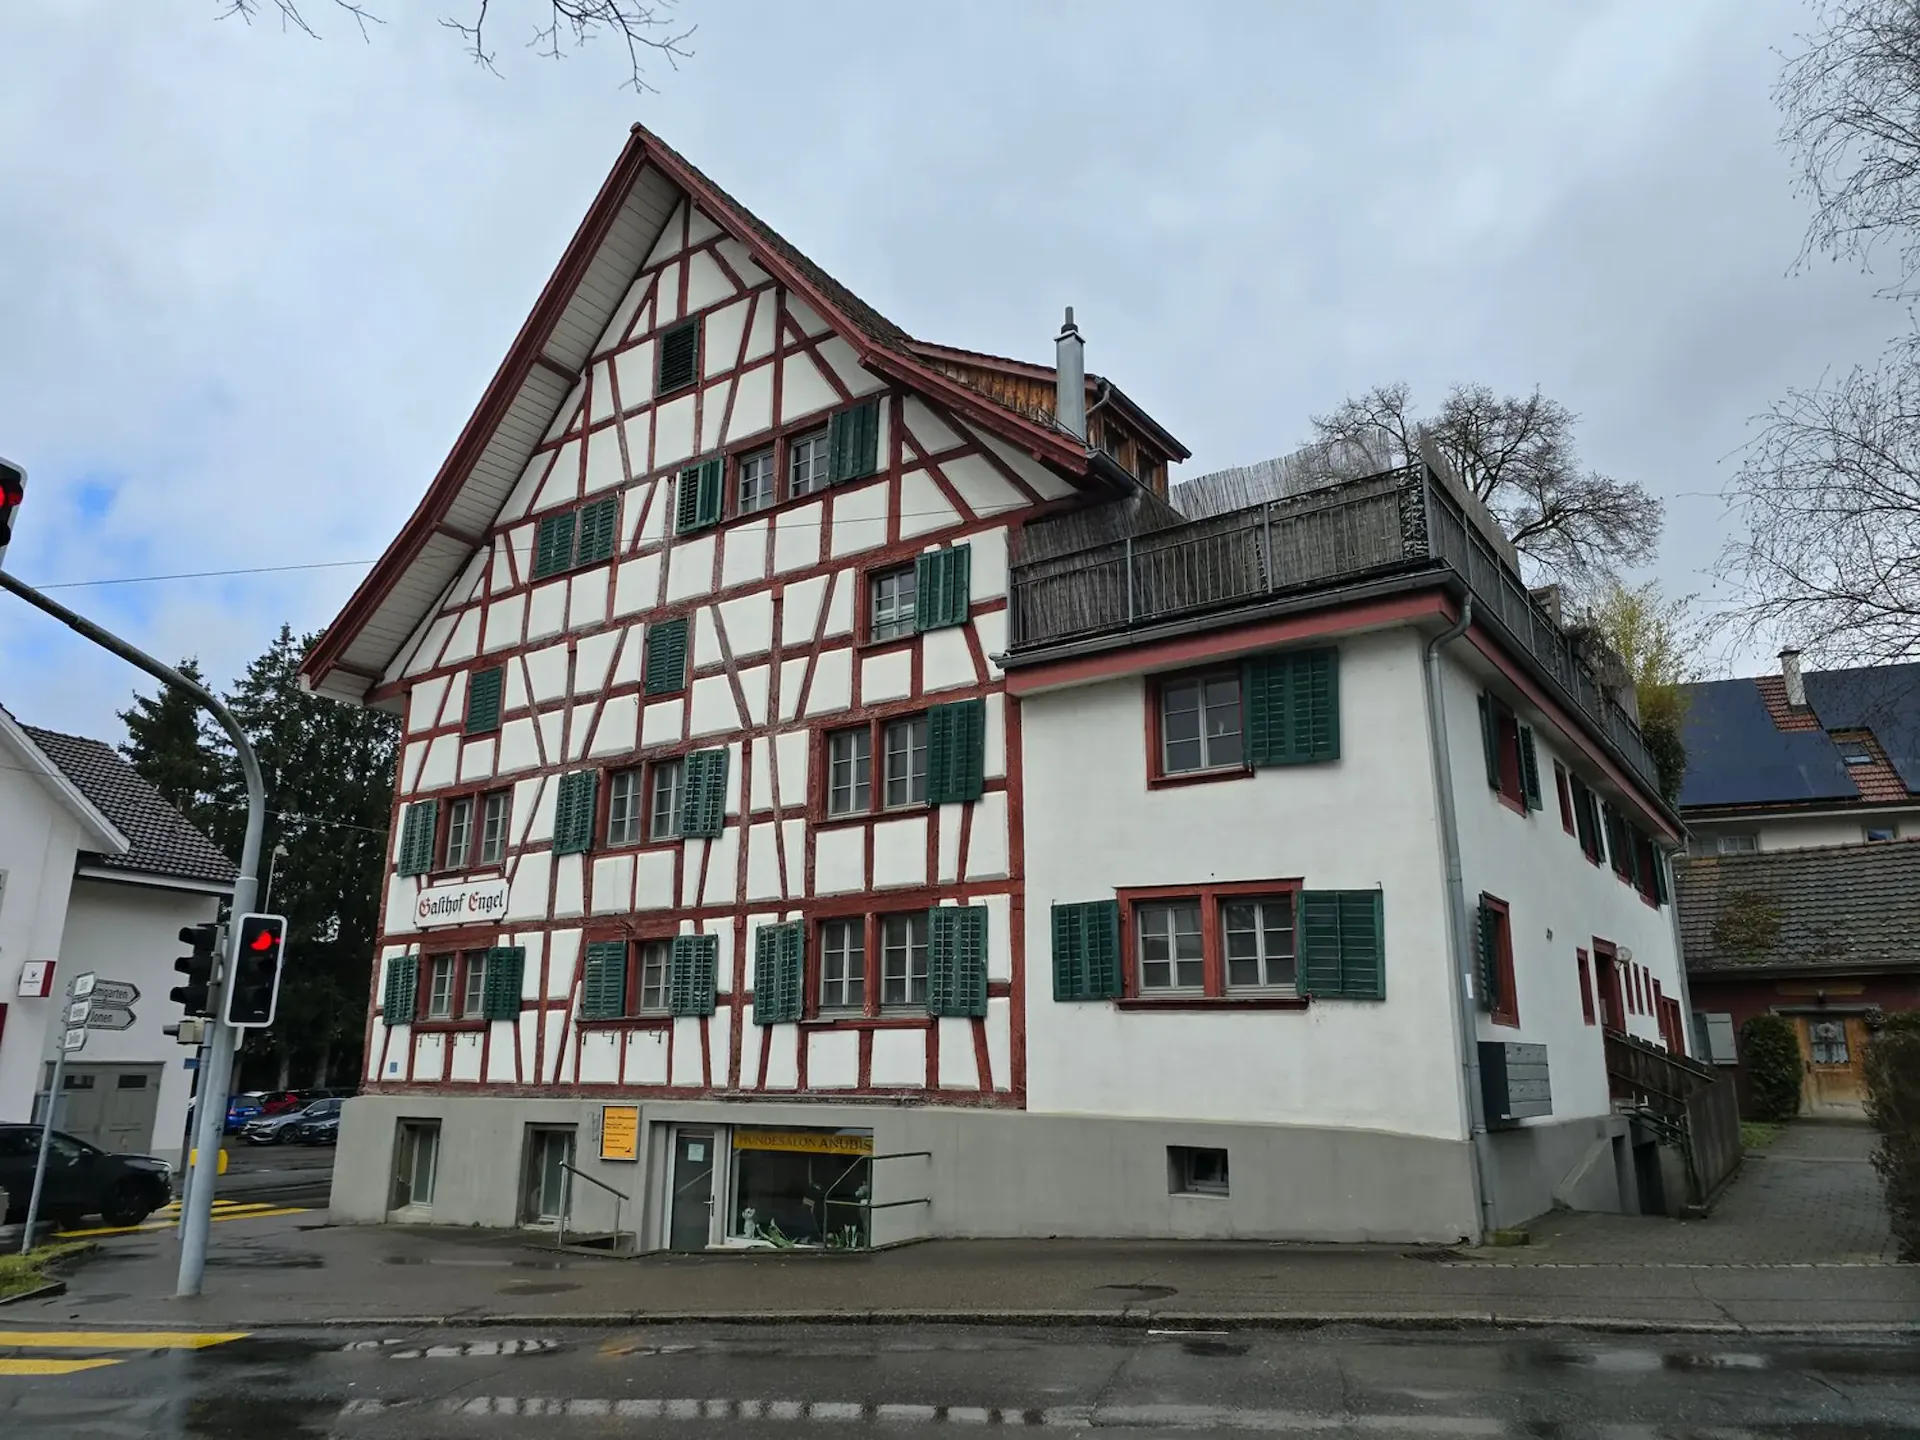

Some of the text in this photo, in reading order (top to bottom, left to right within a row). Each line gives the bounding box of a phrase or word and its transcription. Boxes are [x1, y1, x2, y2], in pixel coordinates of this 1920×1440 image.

[419, 889, 504, 917] Gasthof Engel
[93, 987, 128, 999] emgarten
[818, 1137, 874, 1152] ANUBIS
